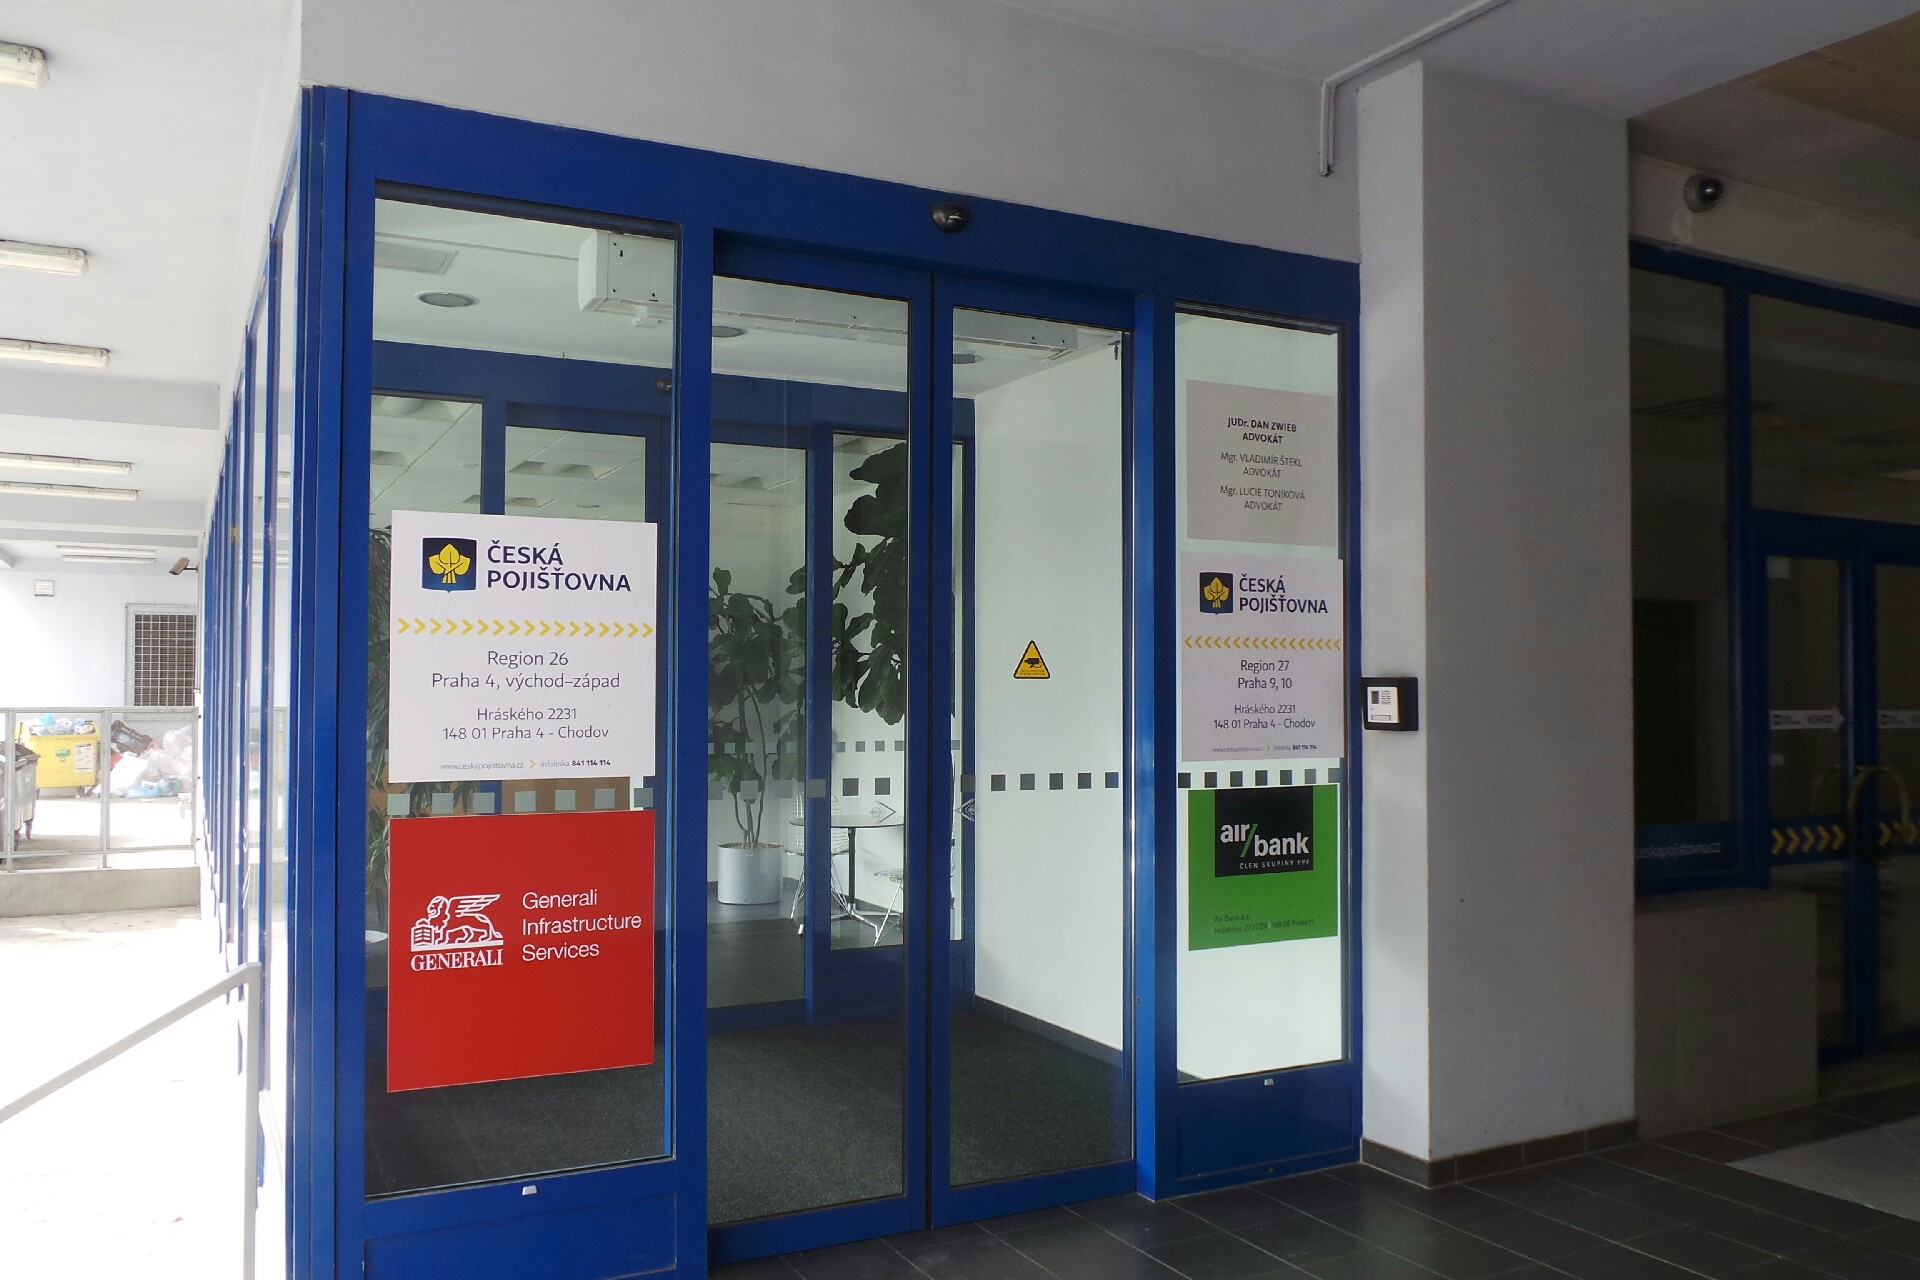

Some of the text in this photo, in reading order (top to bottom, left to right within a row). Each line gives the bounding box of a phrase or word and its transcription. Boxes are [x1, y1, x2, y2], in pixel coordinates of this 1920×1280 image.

[1227, 417, 1297, 432] JUDr. DAN ZWIEB
[1242, 432, 1283, 444] ADVOKÁT
[1220, 452, 1302, 467] Mgr. VLADIMÍR ŠTEKL
[1243, 467, 1281, 478] ADVOKÁT
[1220, 485, 1306, 500] Mgr. LUCIE TONIKOVÁ
[1244, 501, 1282, 511] ADVOKÁT
[487, 539, 563, 565] ČESKÁ
[487, 567, 631, 592] POJIŠŤOVNA
[1239, 573, 1286, 593] ČESKÁ
[1239, 594, 1328, 614] POJIŠŤOVNA
[487, 650, 569, 669] Region 26
[1240, 660, 1290, 674] Region 27
[431, 673, 480, 688] Praha
[485, 674, 500, 691] 4,
[1238, 677, 1292, 690] Praha 9, 10
[477, 707, 577, 721] Hráského 2231
[1234, 704, 1296, 714] Hráského 2231
[1213, 719, 1229, 729] 148
[1231, 719, 1241, 728] 01
[1244, 719, 1268, 728] Praha
[1270, 719, 1275, 728] 4
[1283, 718, 1316, 728] Chodov
[443, 727, 467, 740] 148
[471, 727, 487, 739] 01
[492, 726, 531, 739] Praha
[535, 726, 545, 738] 4
[558, 725, 609, 739] Chodov
[1261, 859, 1294, 868] SKUPINY
[522, 889, 598, 910] Generali
[522, 914, 642, 936] Infrastructure
[521, 942, 600, 962] Services
[410, 948, 504, 972] GENERALI
